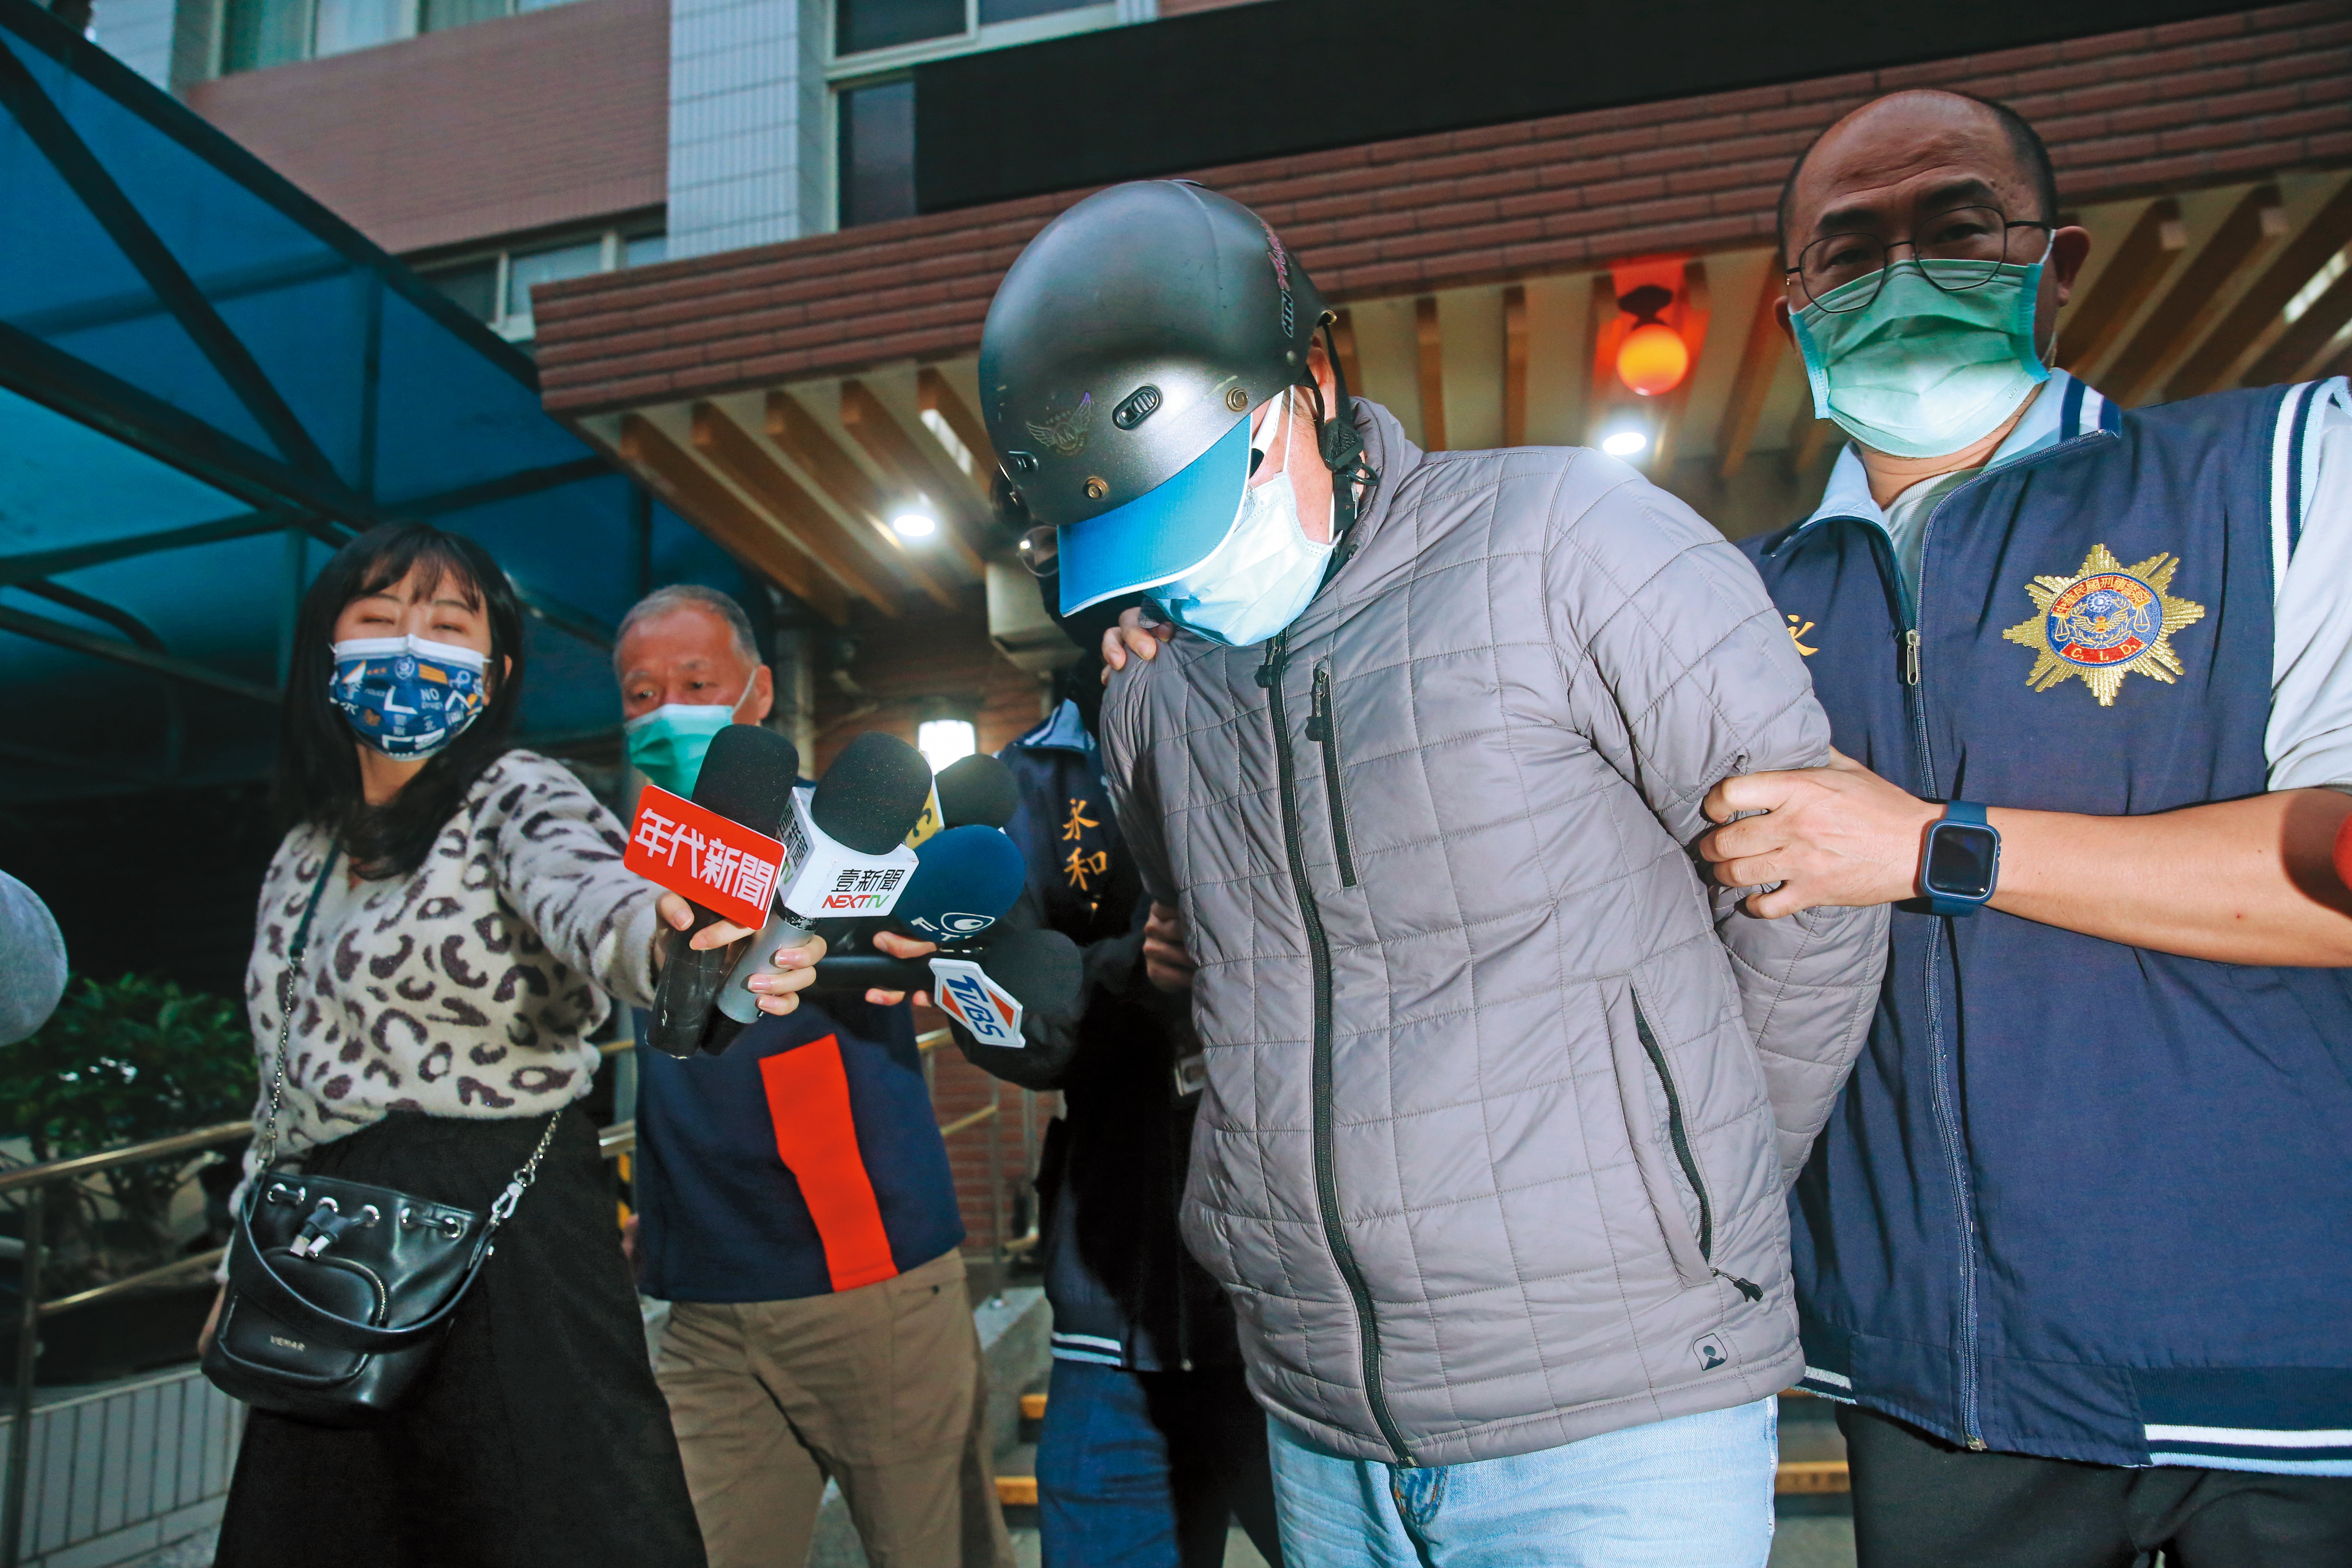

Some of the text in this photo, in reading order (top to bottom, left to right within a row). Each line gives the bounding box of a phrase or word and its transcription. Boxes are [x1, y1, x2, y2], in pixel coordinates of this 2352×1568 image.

[2054, 576, 2152, 615] 中華民國刑事警察
[634, 807, 776, 911] 年代新聞
[1062, 798, 1107, 909] 永和
[831, 869, 906, 892] 壹新聞
[910, 916, 973, 941] FT
[946, 974, 1006, 1038] TVBS
